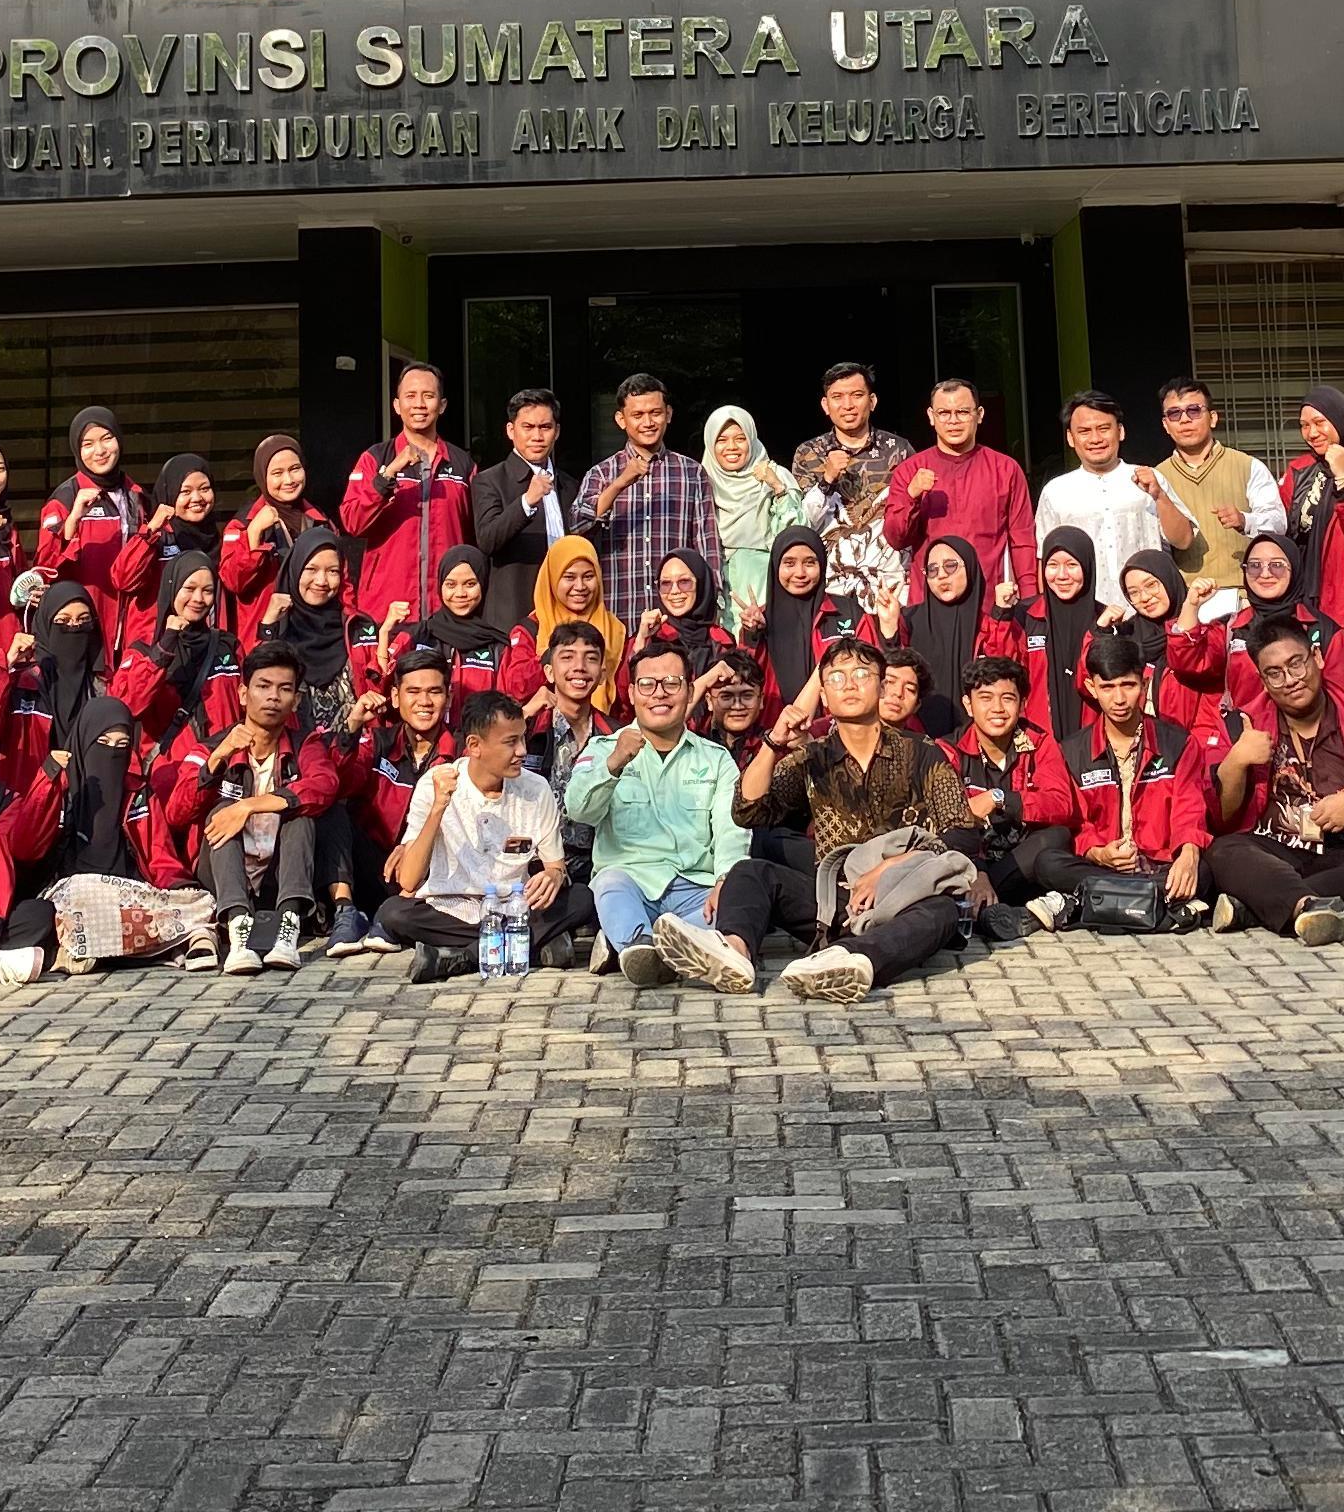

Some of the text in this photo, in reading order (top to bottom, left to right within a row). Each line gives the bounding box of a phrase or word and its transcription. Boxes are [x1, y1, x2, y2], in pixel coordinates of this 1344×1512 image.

[354, 14, 801, 88] SUMATERA
[829, 4, 1110, 73] UTARA
[129, 110, 482, 167] PERLINDUNGAN
[511, 104, 627, 154] ANAK
[655, 102, 738, 152] DAN
[767, 93, 985, 147] KELUARGA
[1016, 86, 1260, 140] BERENCANA
